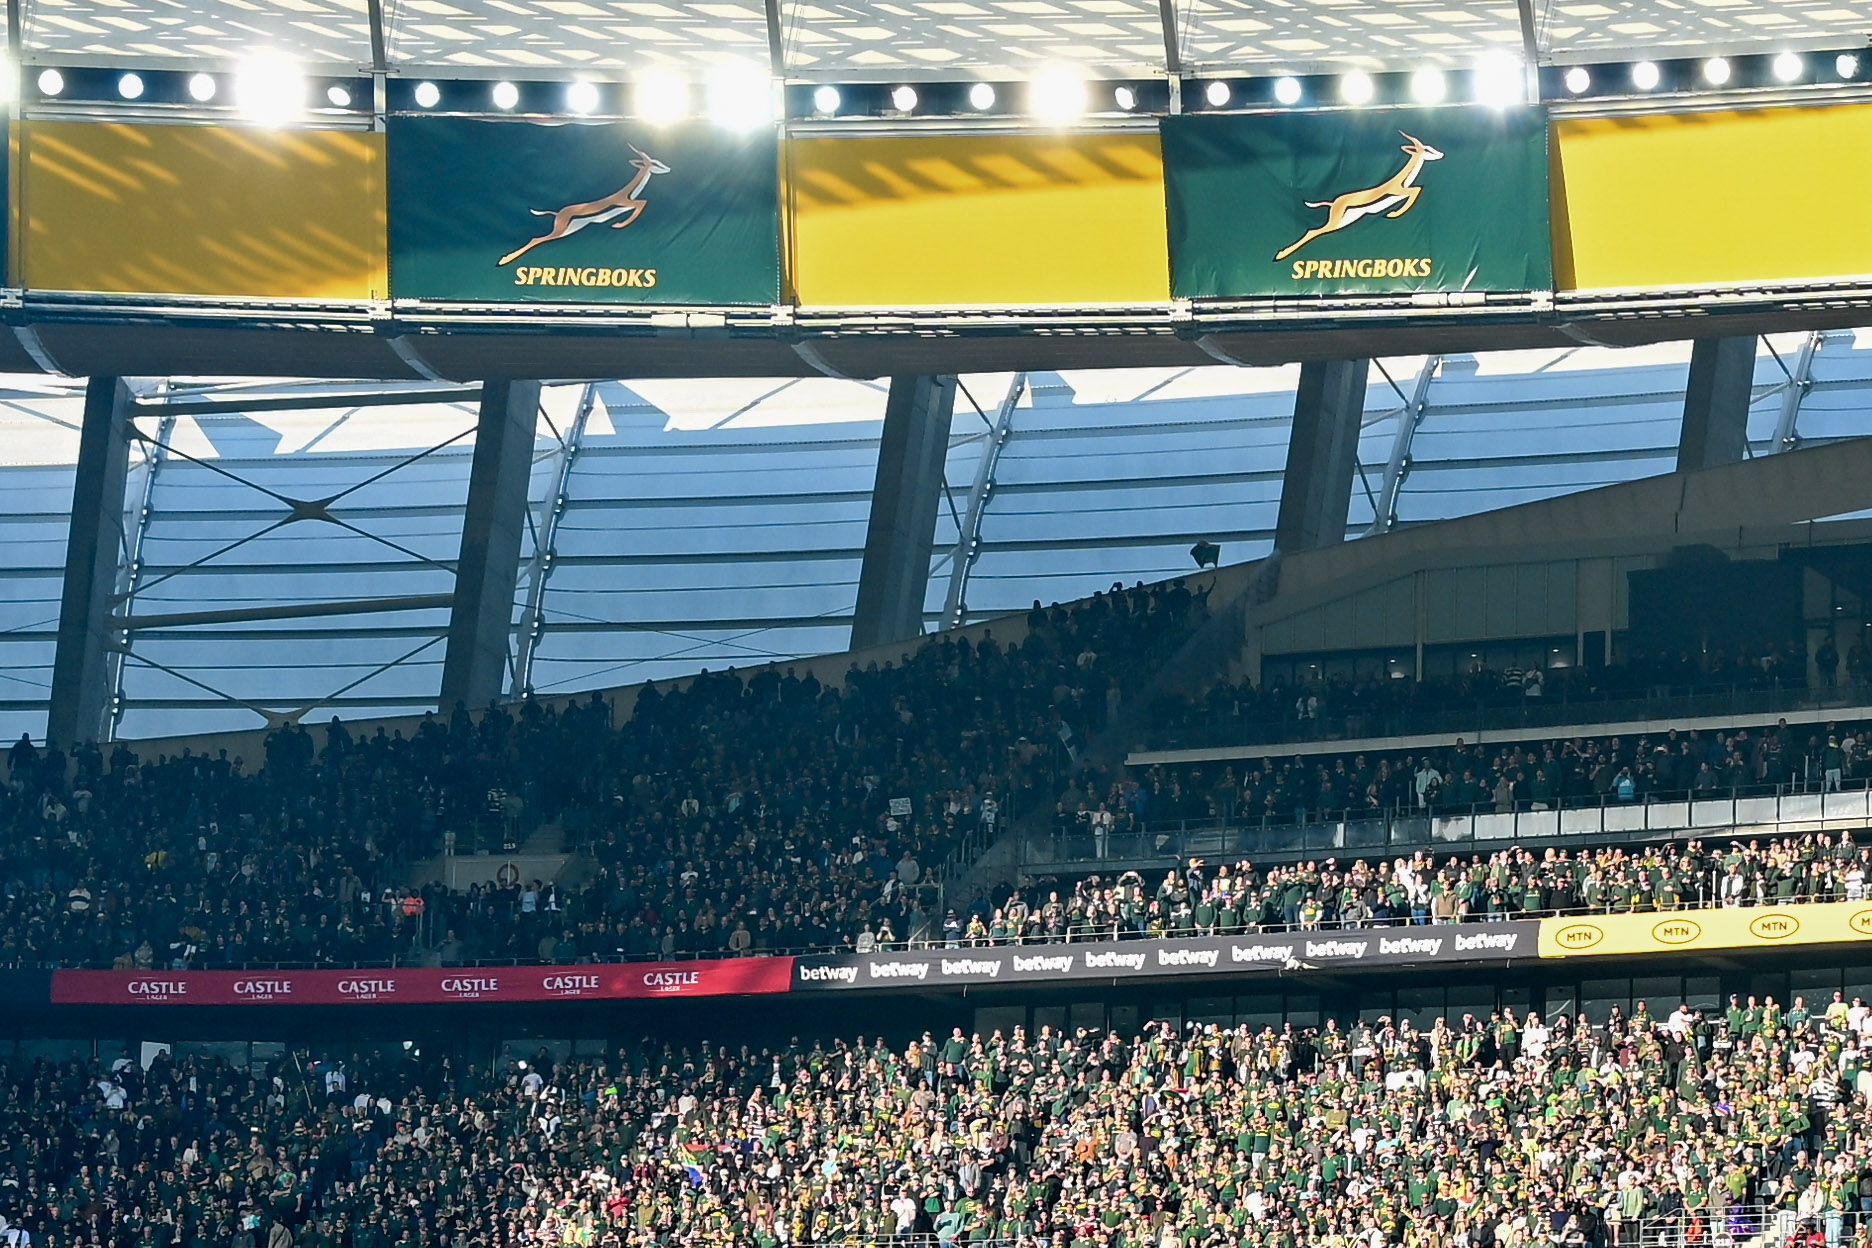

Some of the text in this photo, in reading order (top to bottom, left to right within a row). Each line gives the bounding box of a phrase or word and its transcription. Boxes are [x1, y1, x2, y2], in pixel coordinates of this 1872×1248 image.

[514, 266, 656, 288] SPRINGBOKS
[1291, 258, 1432, 279] SPRINGBOKS
[1663, 926, 1690, 937] MTN
[1761, 921, 1788, 932] MTN
[1454, 933, 1518, 952] betway
[1566, 931, 1592, 942] MTN
[1231, 945, 1293, 963] betway
[1305, 941, 1368, 959] betway
[1379, 937, 1443, 956] betway
[1012, 955, 1074, 975] betway
[1085, 952, 1146, 971] betway
[1158, 949, 1219, 968] betway
[799, 966, 859, 983] betway
[869, 962, 929, 980] betway
[941, 959, 1001, 978] betway
[233, 980, 292, 994] CASTLE
[337, 980, 396, 993] CASTLE
[440, 977, 499, 992] CASTLE
[542, 975, 599, 990] CASTLE
[643, 971, 700, 986] CASTLE
[127, 981, 187, 995] CASTLE
